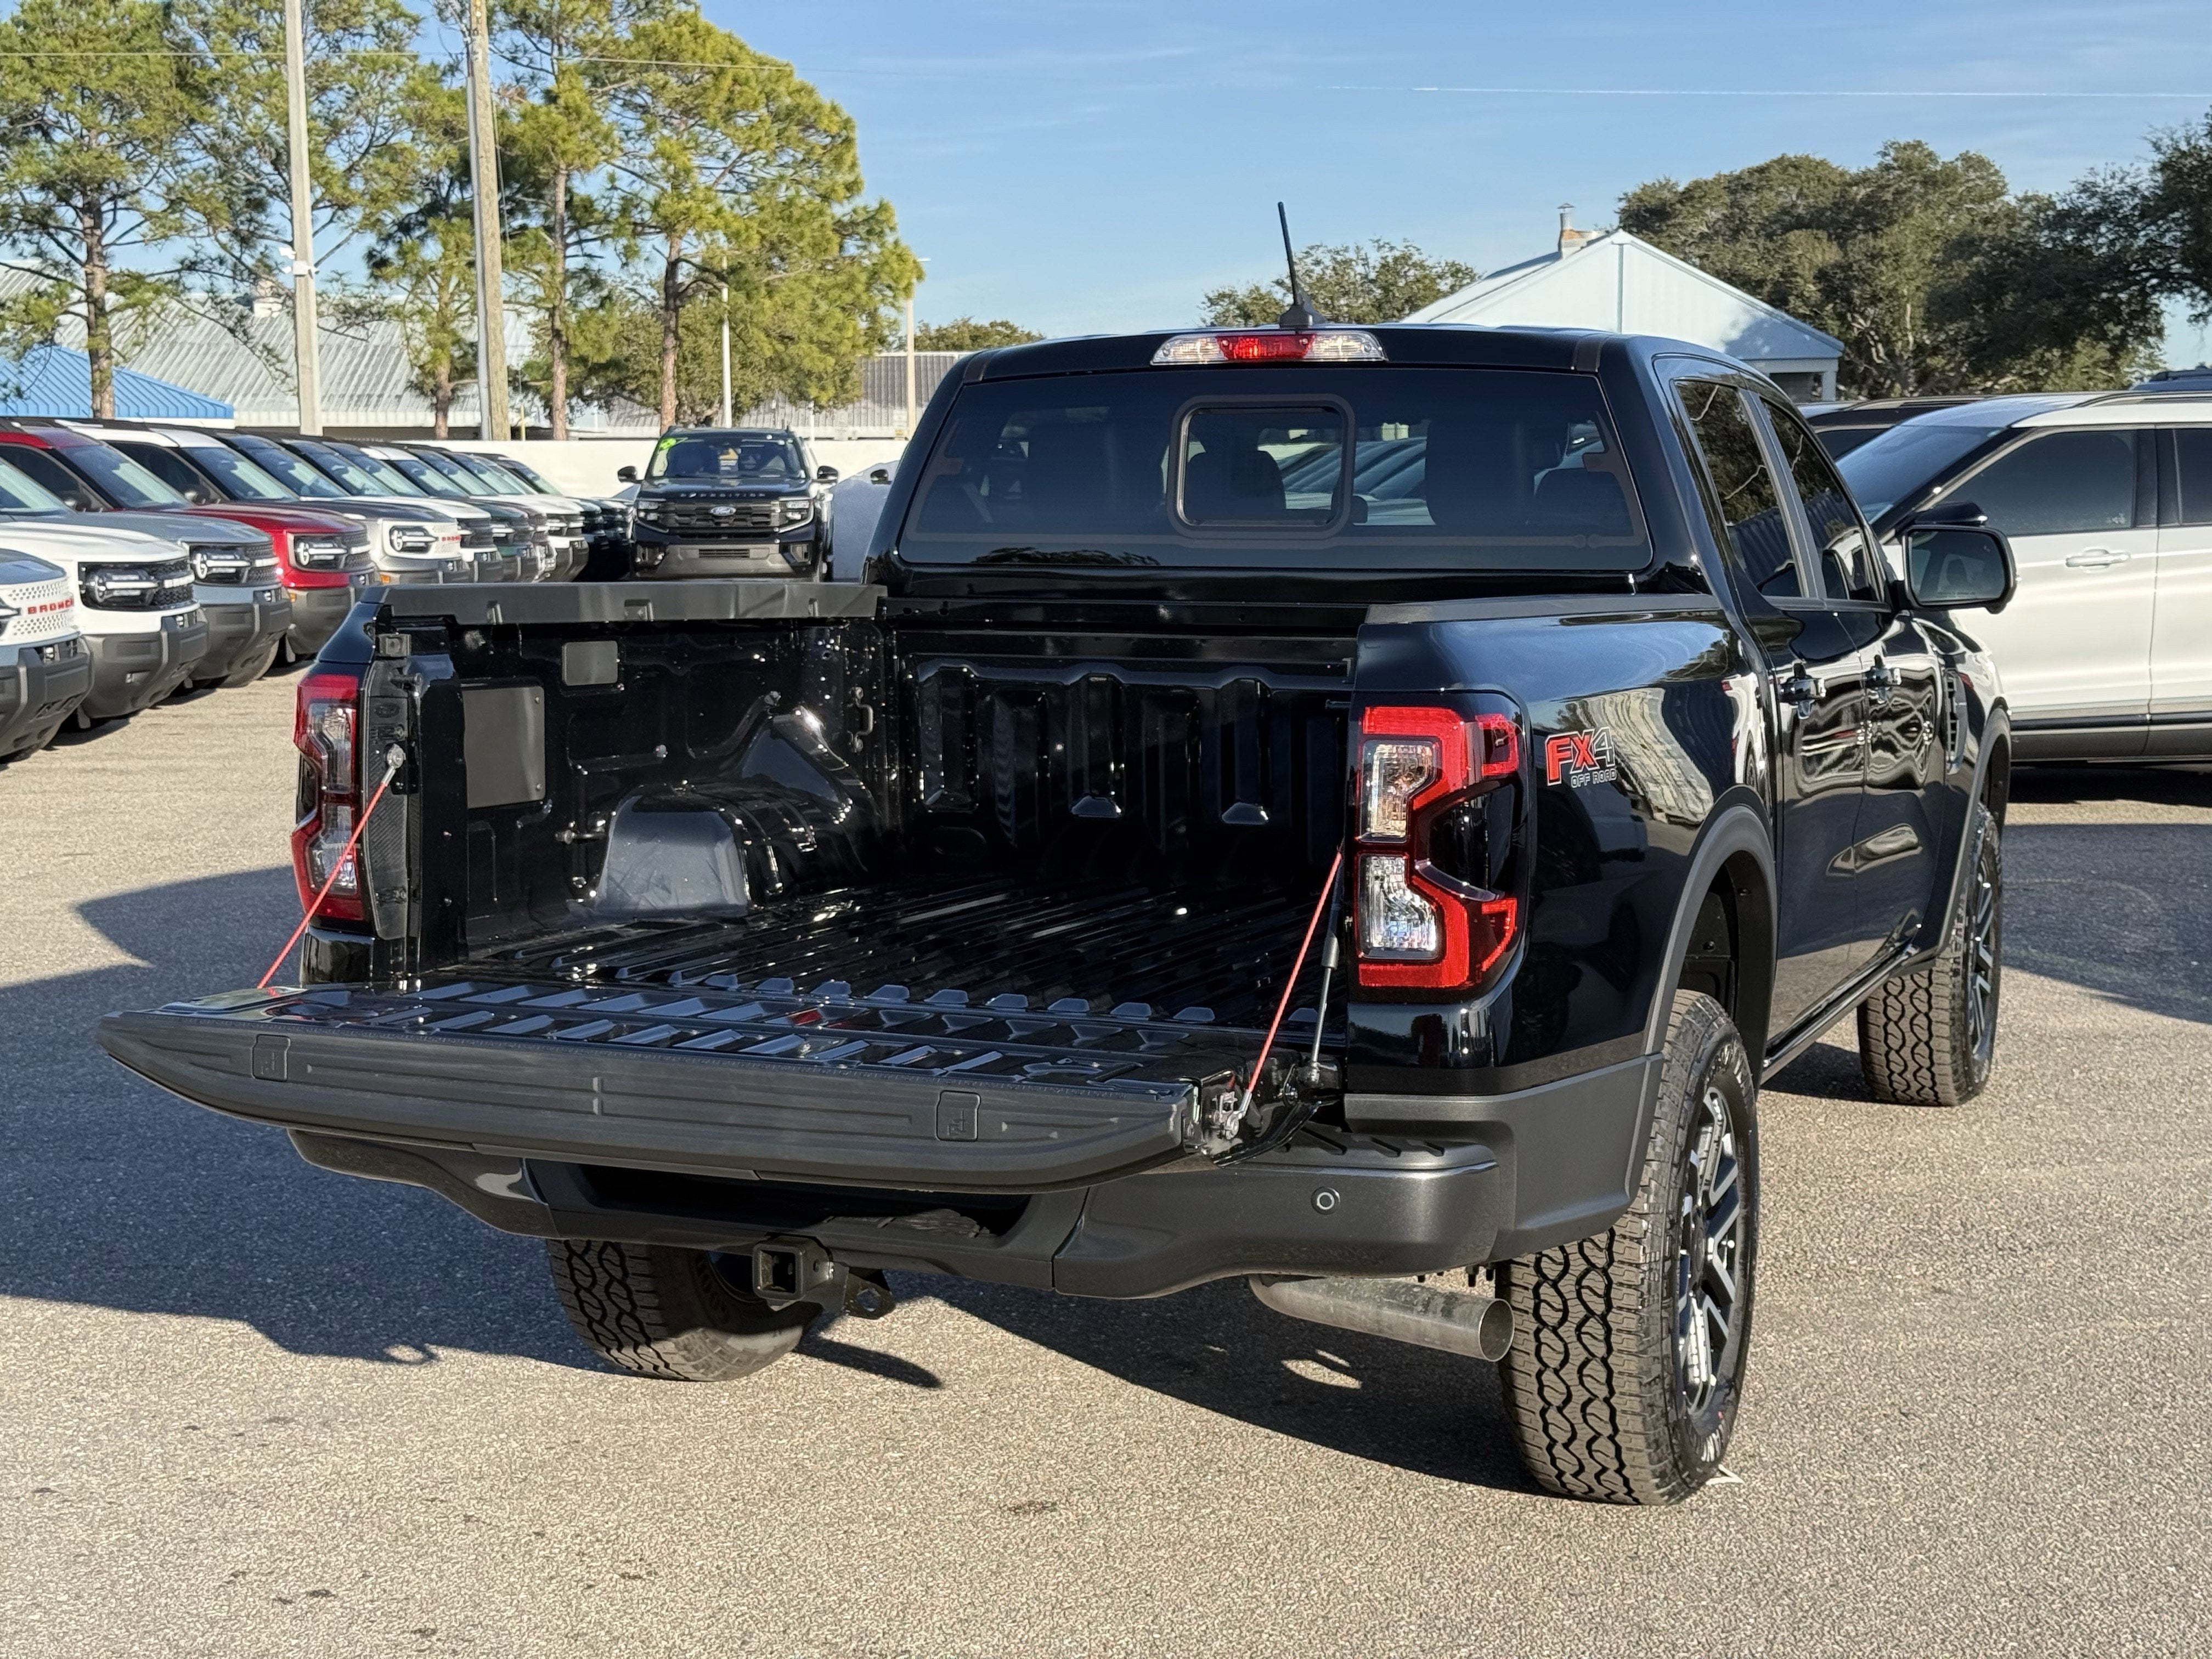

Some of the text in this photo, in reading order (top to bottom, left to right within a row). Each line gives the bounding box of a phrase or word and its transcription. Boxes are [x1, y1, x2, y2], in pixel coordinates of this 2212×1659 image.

[27, 597, 74, 614] BRONC
[1545, 726, 1616, 786] FX4
[1571, 768, 1617, 788] OFF ROAD
